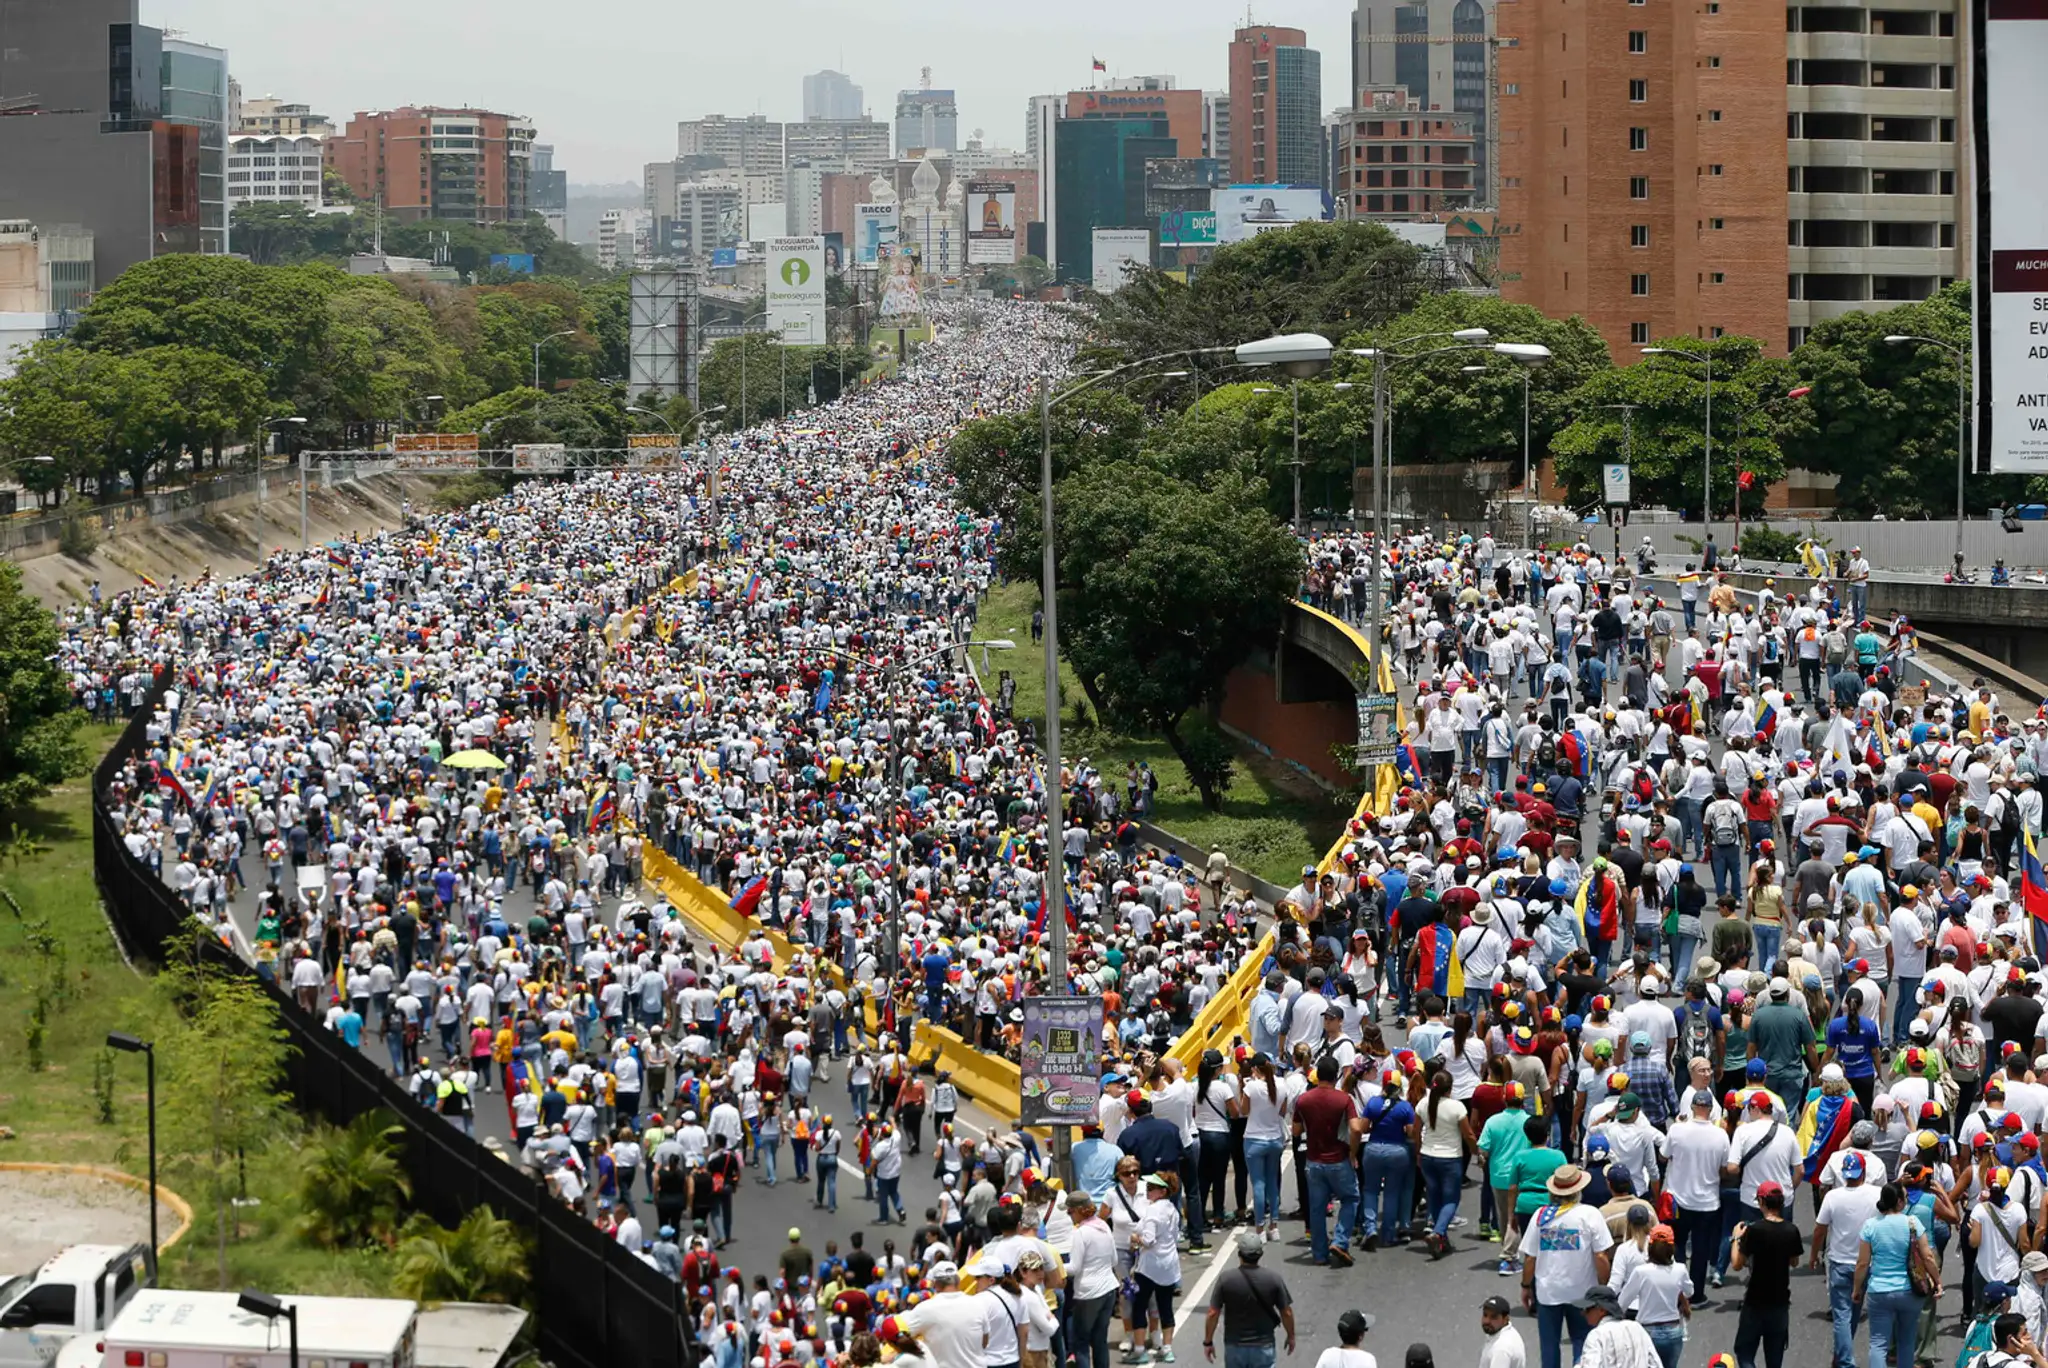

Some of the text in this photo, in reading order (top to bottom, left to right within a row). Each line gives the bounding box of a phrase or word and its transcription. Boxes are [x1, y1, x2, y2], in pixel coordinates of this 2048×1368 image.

[1099, 94, 1164, 105] Banesco
[2015, 260, 2048, 270] MUCH
[770, 292, 822, 301] iberoseguros
[2030, 322, 2048, 334] EV
[2028, 346, 2048, 358] AD
[2016, 394, 2048, 407] ANT
[1358, 712, 1370, 724] 15
[1360, 726, 1370, 738] 16
[1072, 1096, 1096, 1105] COMIC
